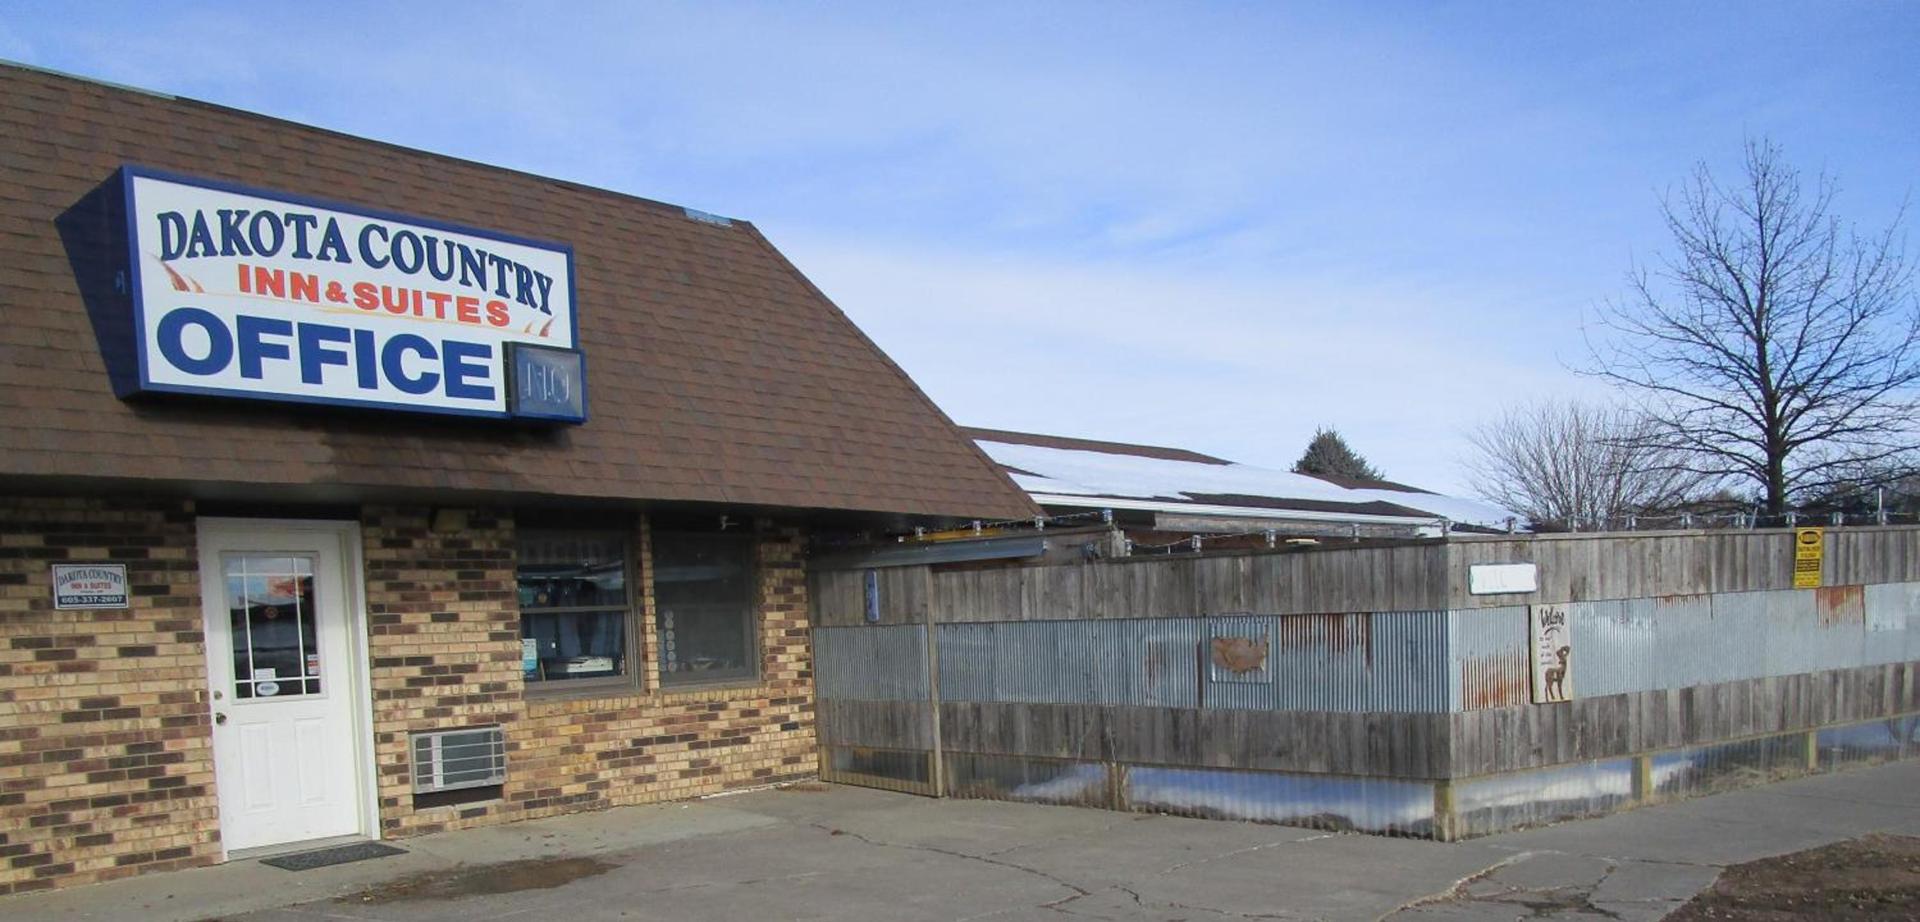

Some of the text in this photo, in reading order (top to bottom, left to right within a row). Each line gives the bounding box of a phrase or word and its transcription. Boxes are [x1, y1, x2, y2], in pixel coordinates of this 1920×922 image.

[156, 209, 554, 316] DAKOTA COUNTRY
[156, 306, 496, 401] OFFICE
[58, 569, 122, 586] DAKOTA COUNTRY
